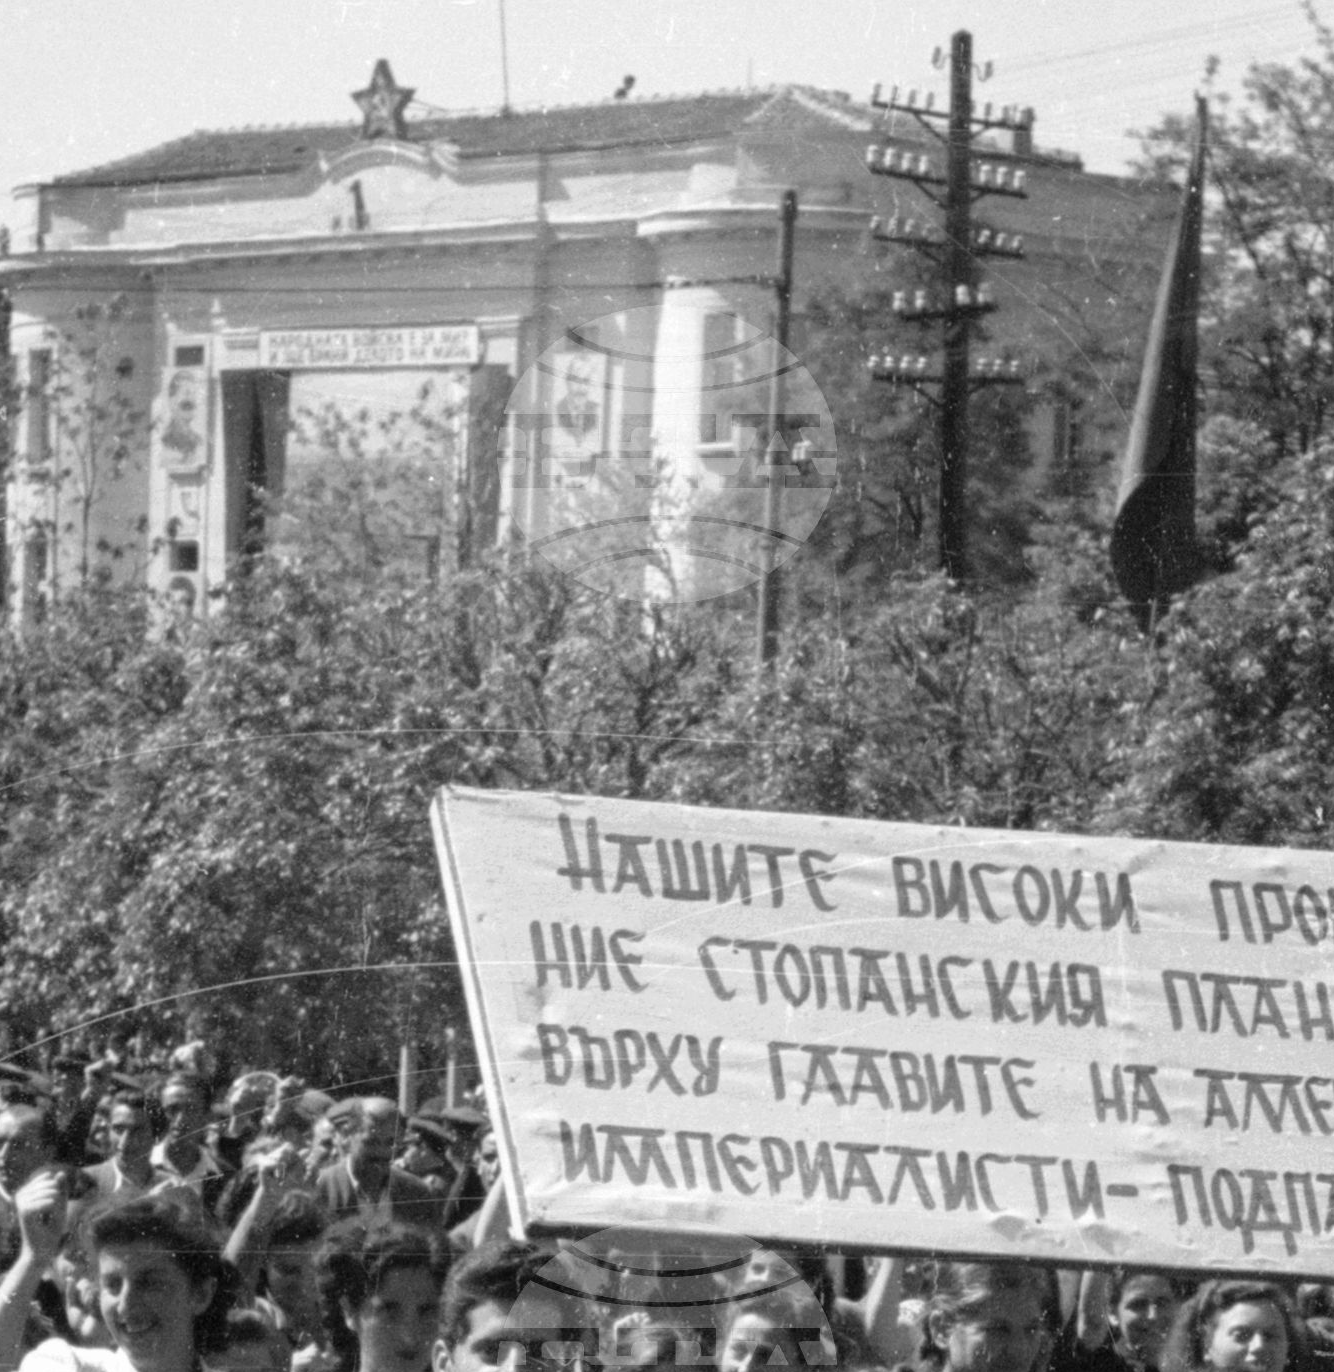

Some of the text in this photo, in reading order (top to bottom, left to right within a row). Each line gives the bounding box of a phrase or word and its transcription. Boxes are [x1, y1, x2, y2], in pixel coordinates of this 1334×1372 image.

[556, 812, 840, 912] НАШИТЕ
[891, 855, 1142, 935] ВИСОКИ
[529, 919, 651, 993] НИЕ
[696, 935, 1108, 1028] СТОПАНСКИЯ
[535, 1021, 724, 1097] ВЪРХУ
[767, 1040, 1043, 1121] ГЛАВИТЕ
[1088, 1060, 1172, 1126] НА
